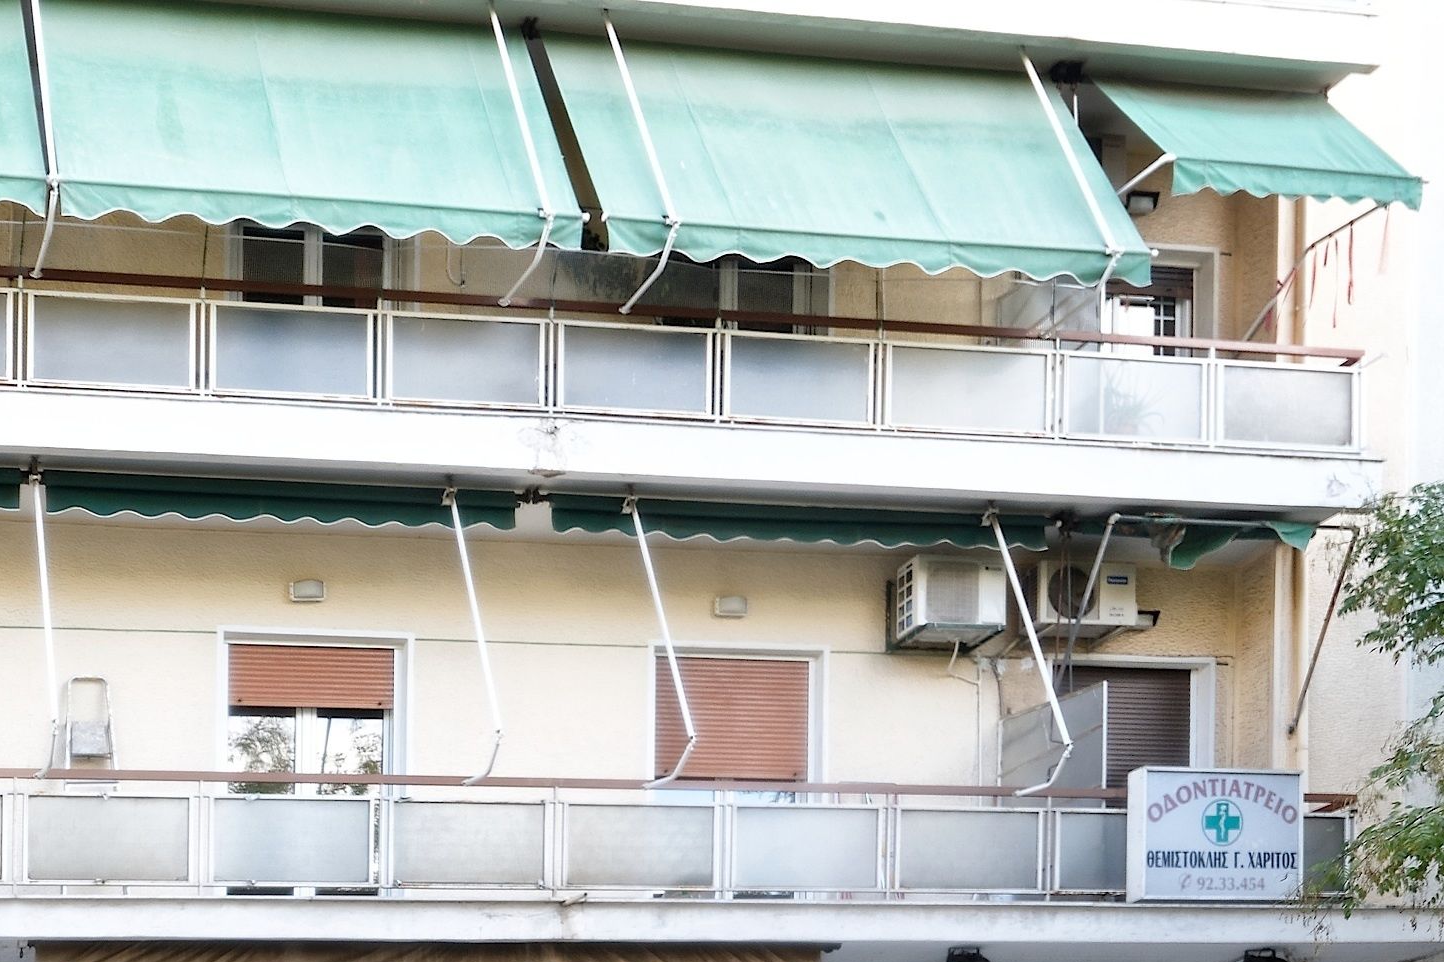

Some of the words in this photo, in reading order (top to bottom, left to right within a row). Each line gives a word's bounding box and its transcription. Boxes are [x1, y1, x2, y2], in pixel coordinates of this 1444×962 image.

[1147, 778, 1298, 824] ΟΔΟΝΤΙΑΤΡΕΙΟ
[1147, 850, 1228, 869] ΘΕΜΙΣΤΟΚΛΗΣ
[1234, 852, 1244, 869] Γ.
[1248, 851, 1298, 870] ΧΑΡΙΤΟΣ
[1197, 876, 1265, 891] 92.33.454
